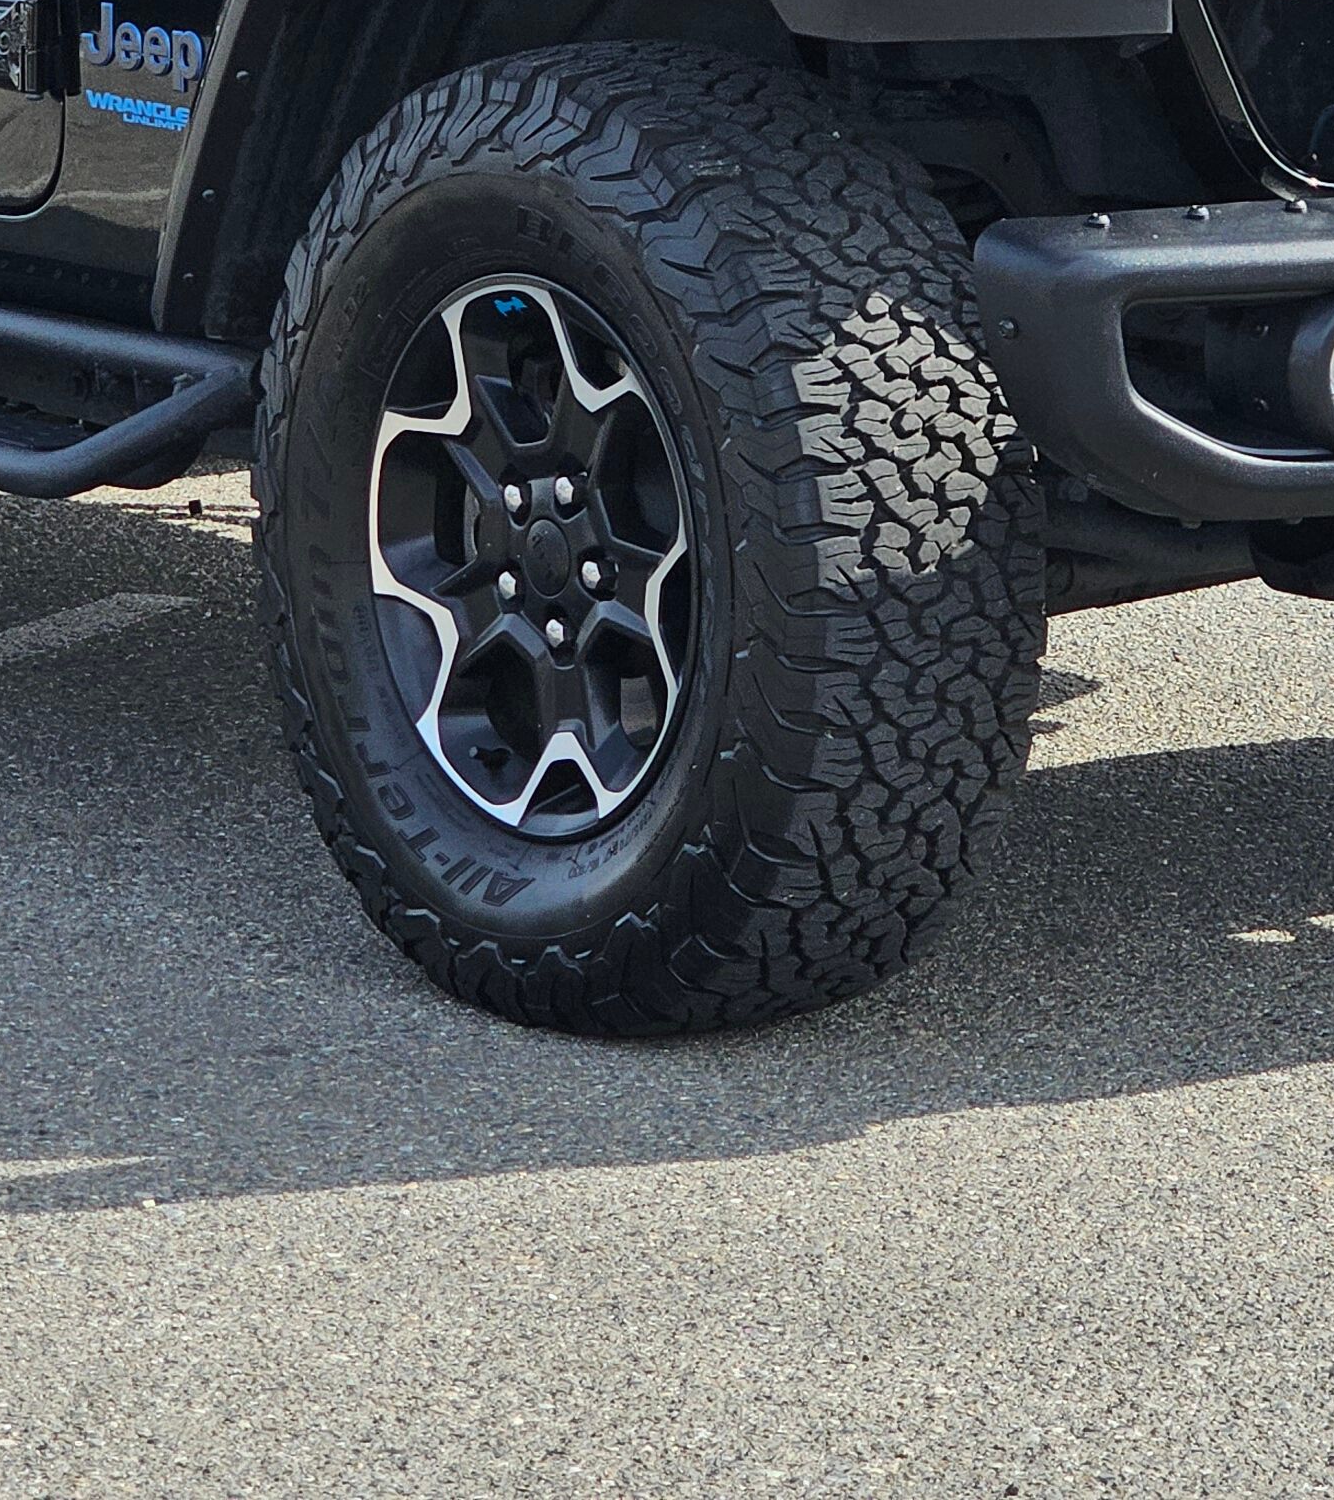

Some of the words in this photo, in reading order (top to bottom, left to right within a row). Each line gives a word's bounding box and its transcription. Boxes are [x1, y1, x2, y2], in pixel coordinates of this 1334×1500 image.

[80, 2, 204, 93] Jeep
[85, 89, 191, 123] WRANGLE
[122, 112, 187, 132] UNLIMIT
